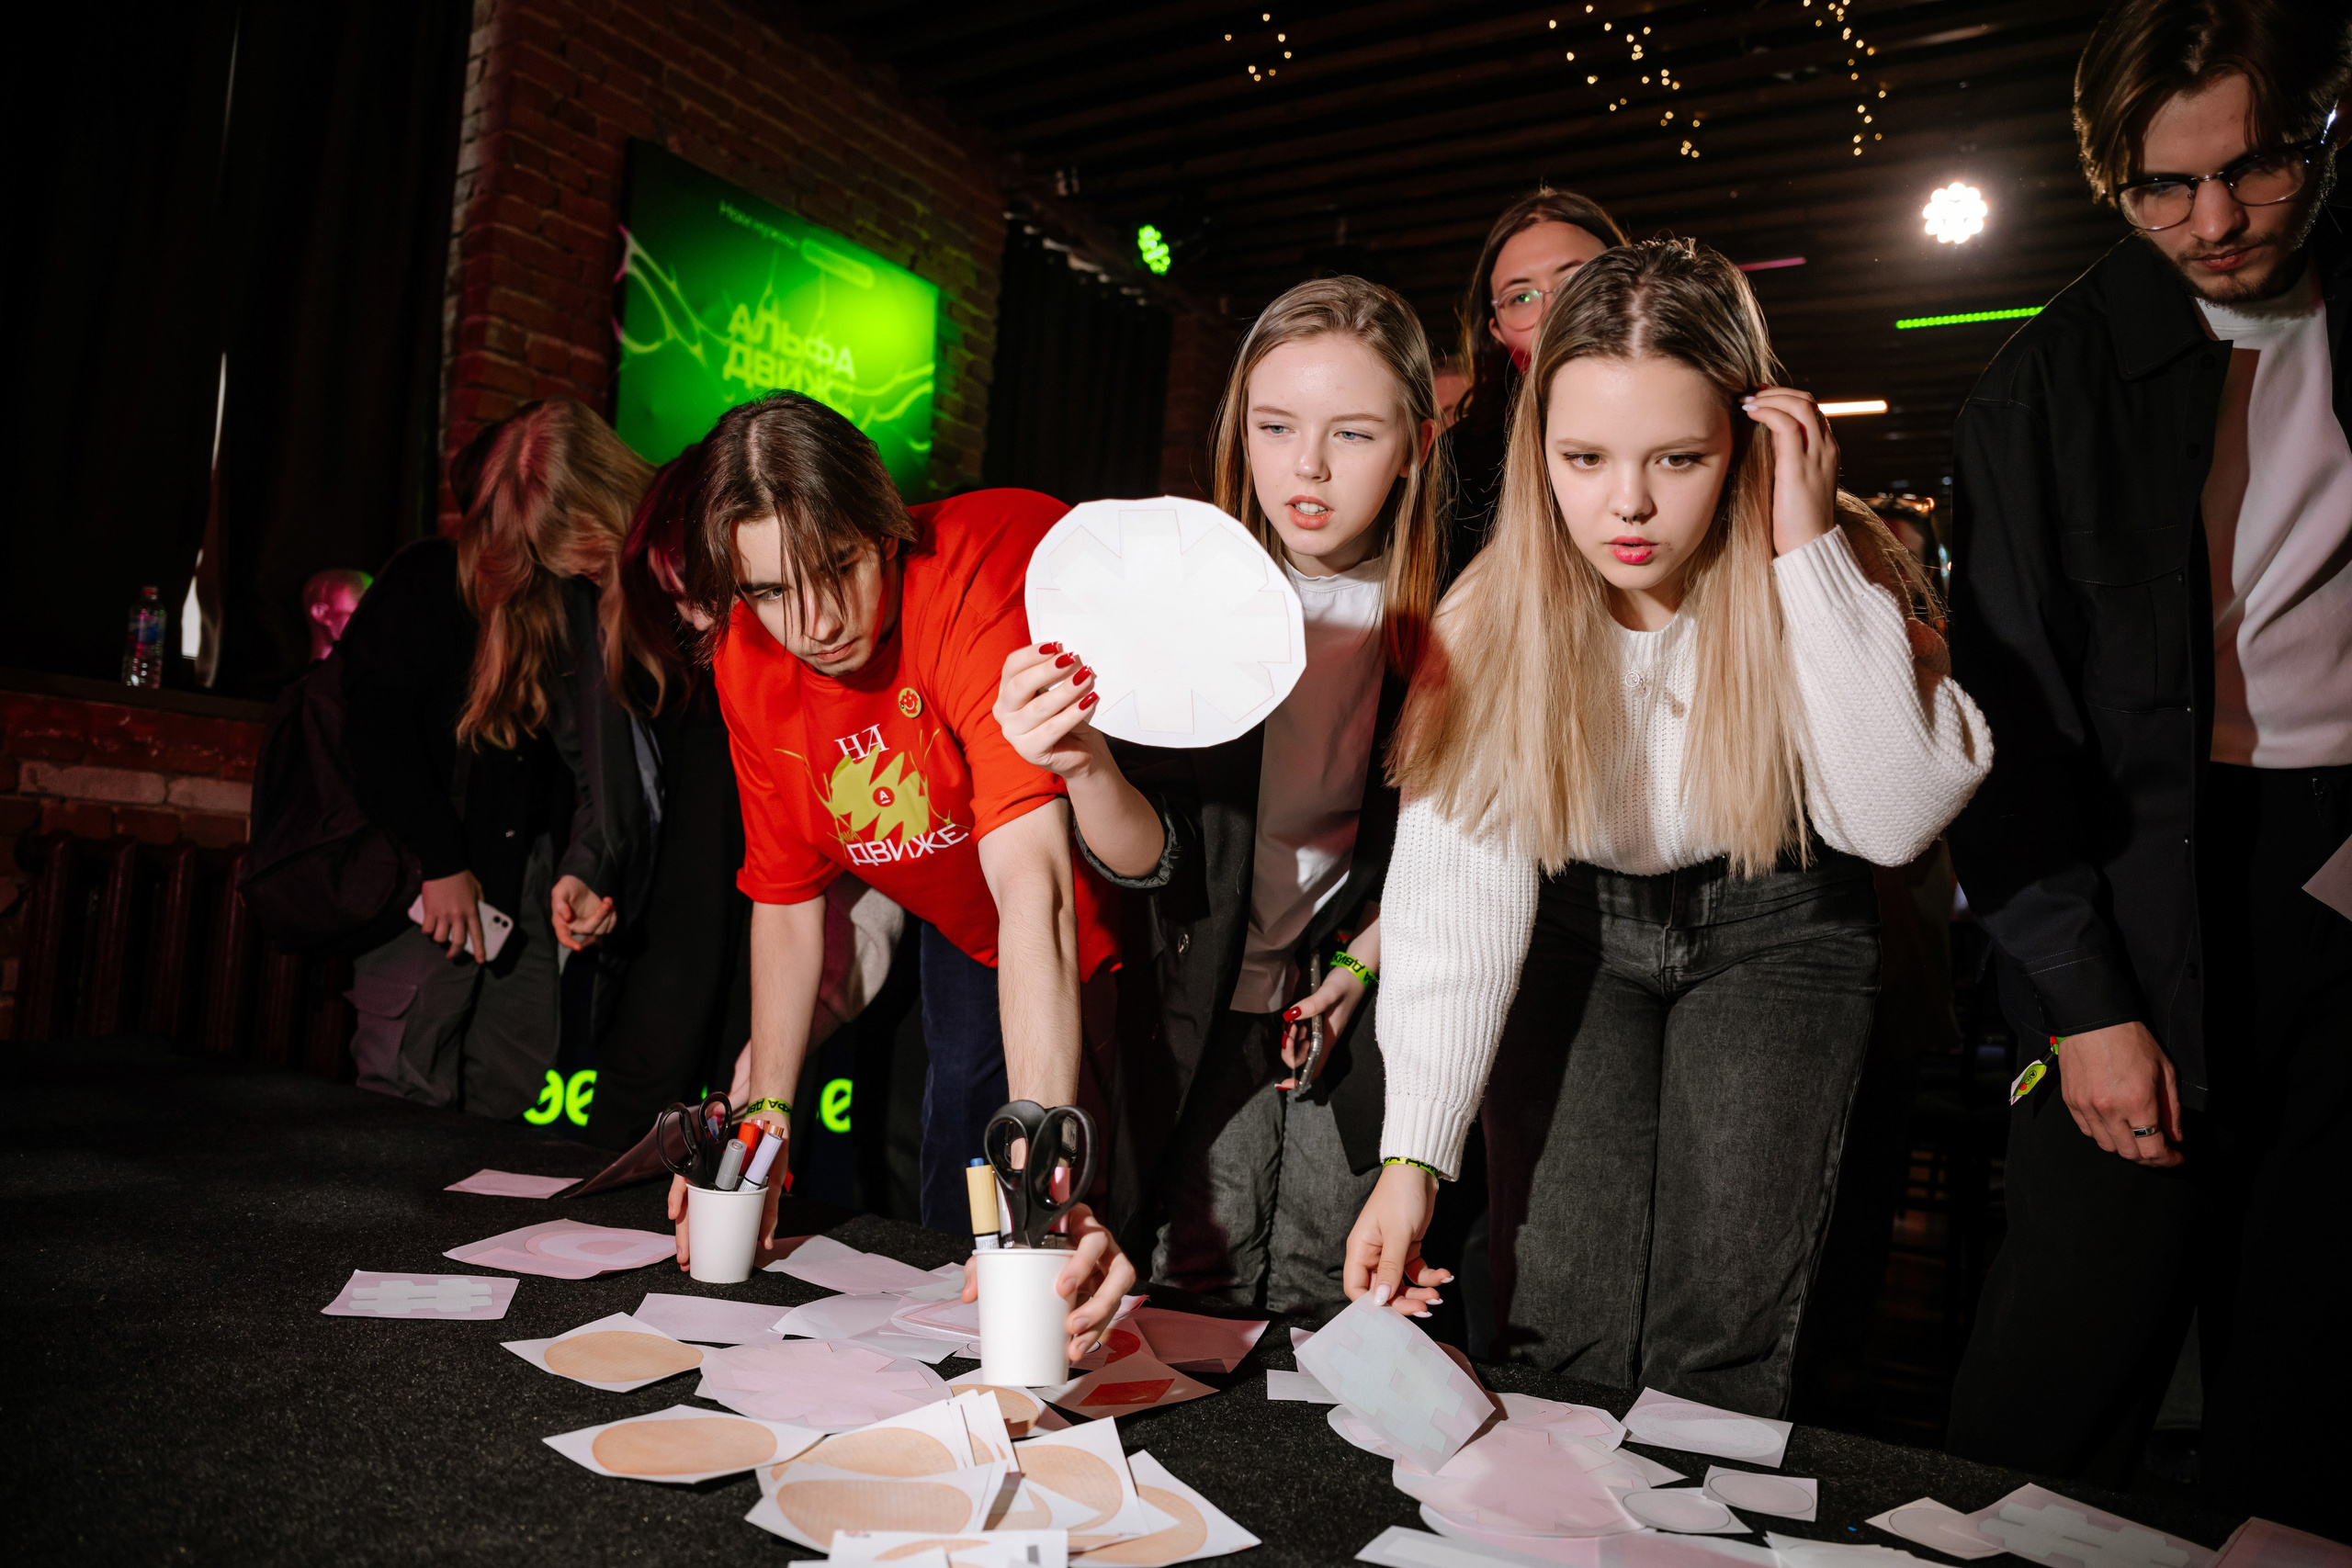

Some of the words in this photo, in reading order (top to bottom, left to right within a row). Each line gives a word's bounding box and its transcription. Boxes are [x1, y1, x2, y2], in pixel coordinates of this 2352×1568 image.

[728, 302, 856, 381] АЛЬФА
[834, 724, 890, 761] НА
[846, 823, 969, 866] ДВИЖЕ
